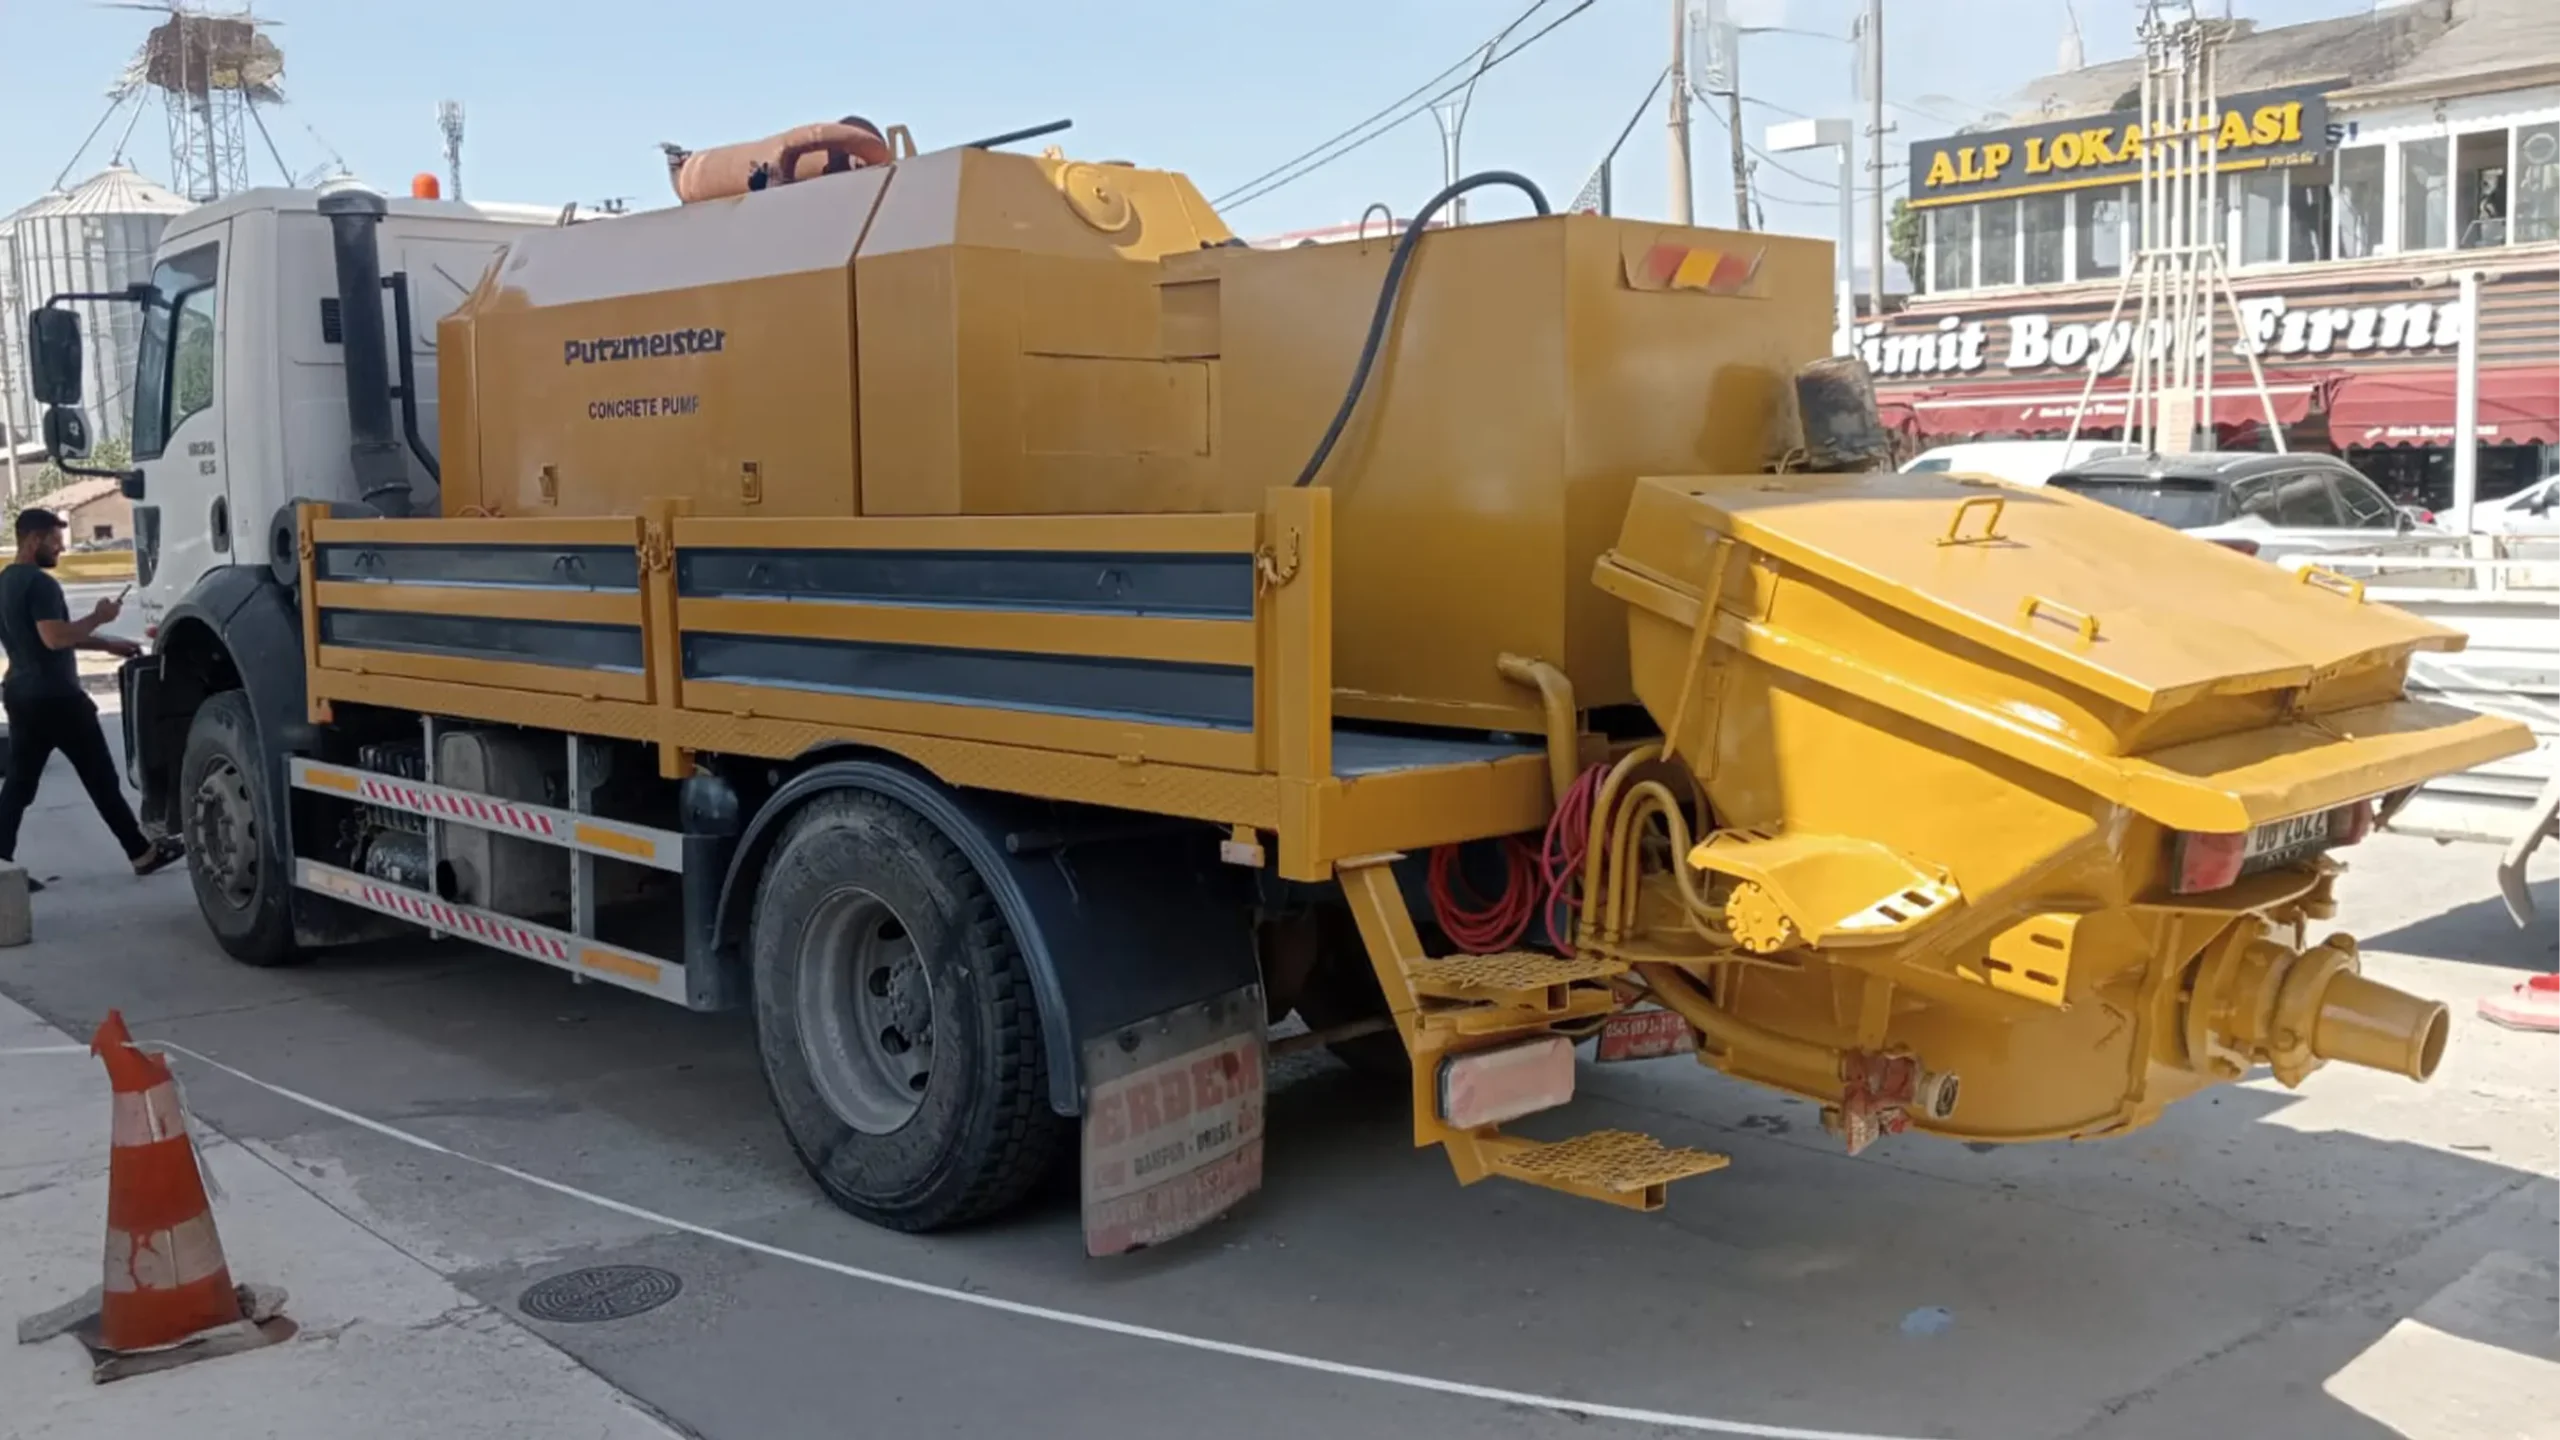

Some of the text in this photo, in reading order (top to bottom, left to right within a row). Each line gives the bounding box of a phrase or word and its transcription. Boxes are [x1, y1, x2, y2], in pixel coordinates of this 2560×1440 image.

[1924, 142, 2011, 186] ALP
[564, 327, 727, 366] Putzmeister
[2004, 313, 2213, 374] Boyo
[588, 395, 699, 420] CONCRETE PUMP
[1094, 1041, 1259, 1148] ERDEM
